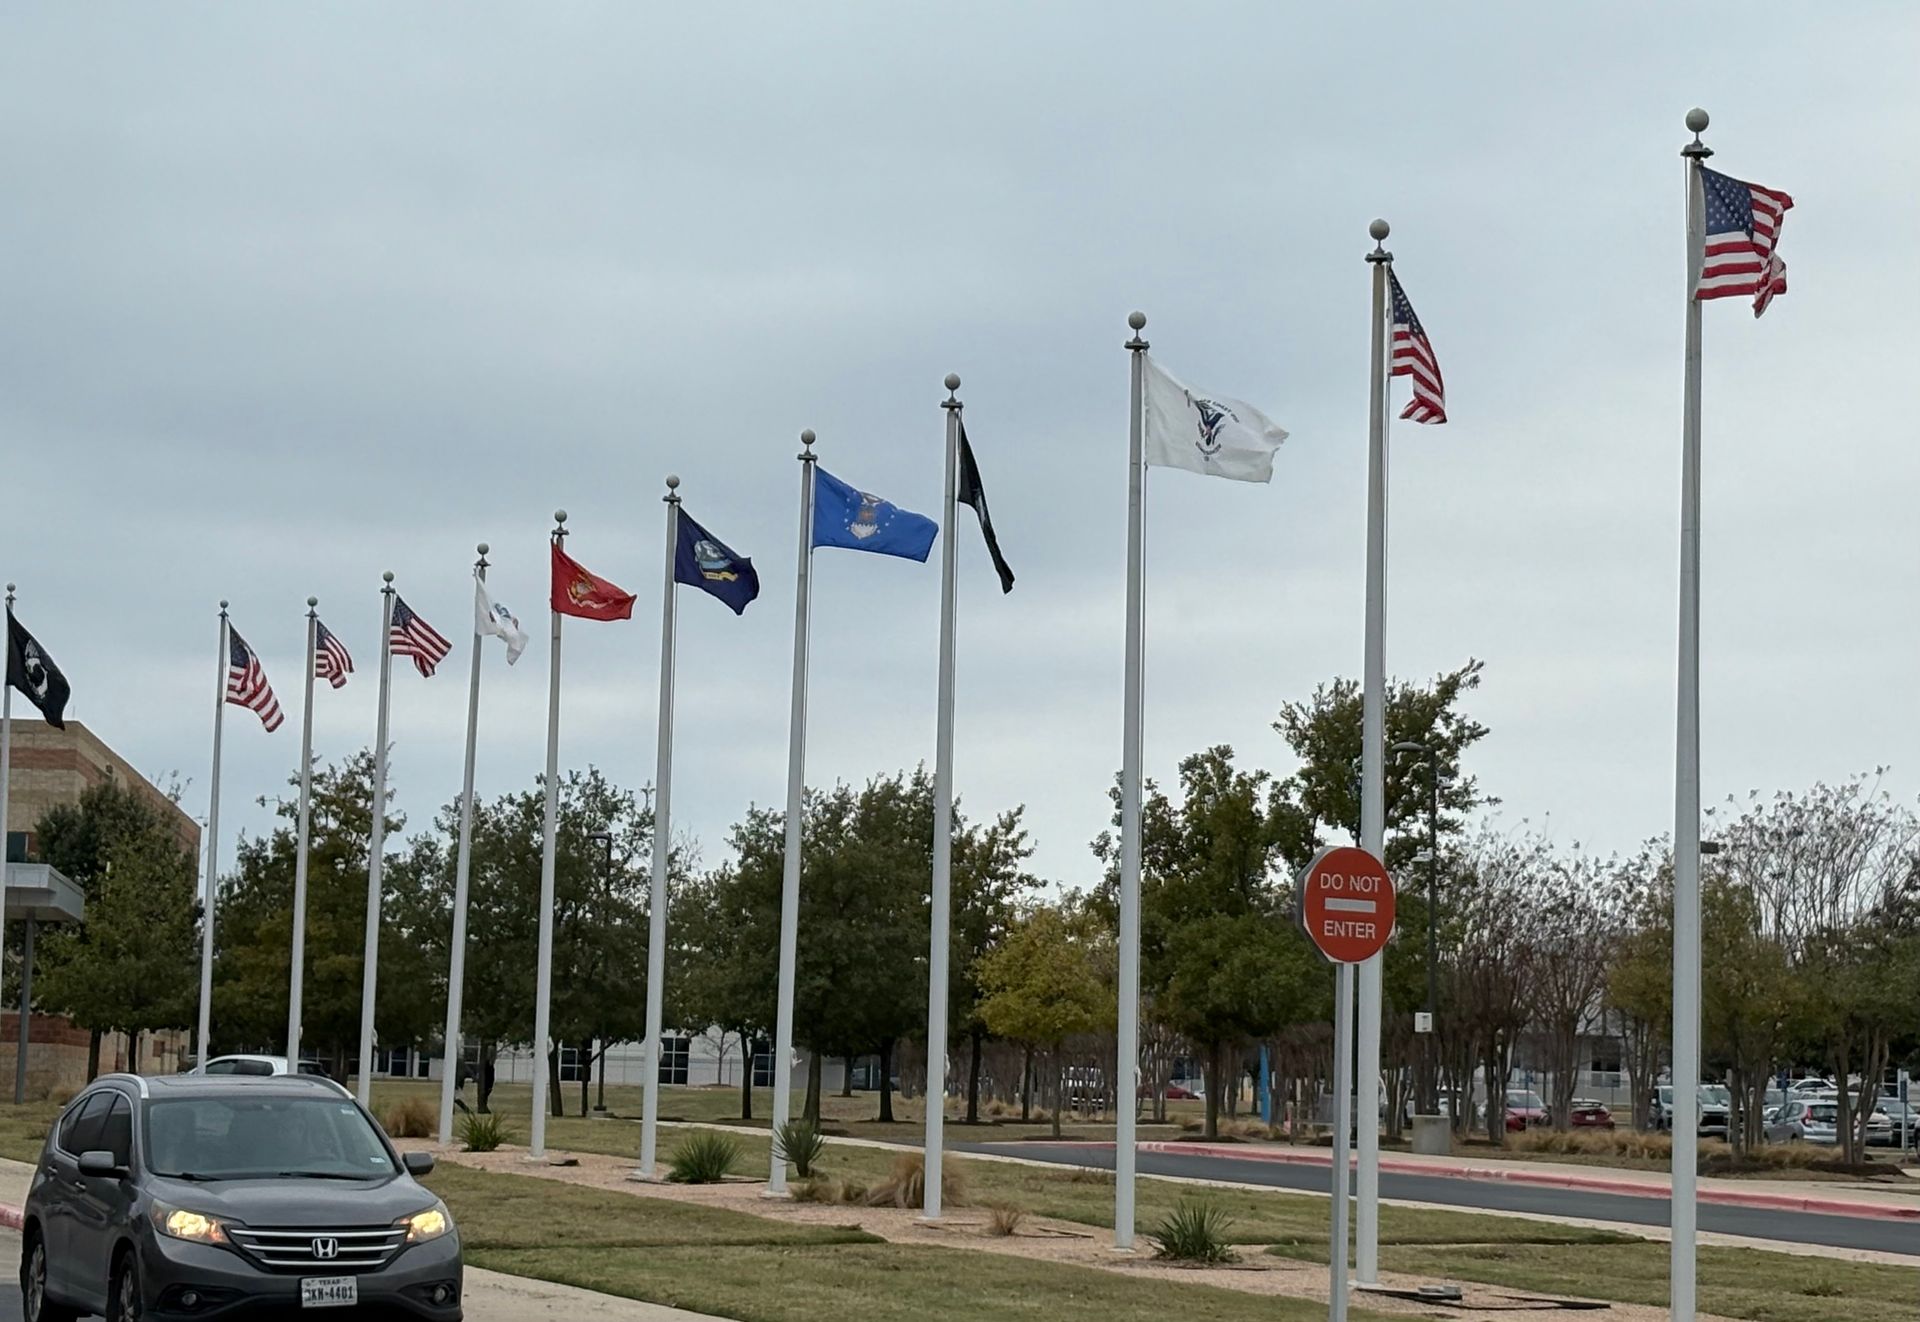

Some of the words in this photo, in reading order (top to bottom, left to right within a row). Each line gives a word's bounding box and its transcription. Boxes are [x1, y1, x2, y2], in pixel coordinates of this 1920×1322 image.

[1320, 873, 1344, 890] DO
[1349, 875, 1382, 893] NOT
[1323, 920, 1376, 939] ENTER
